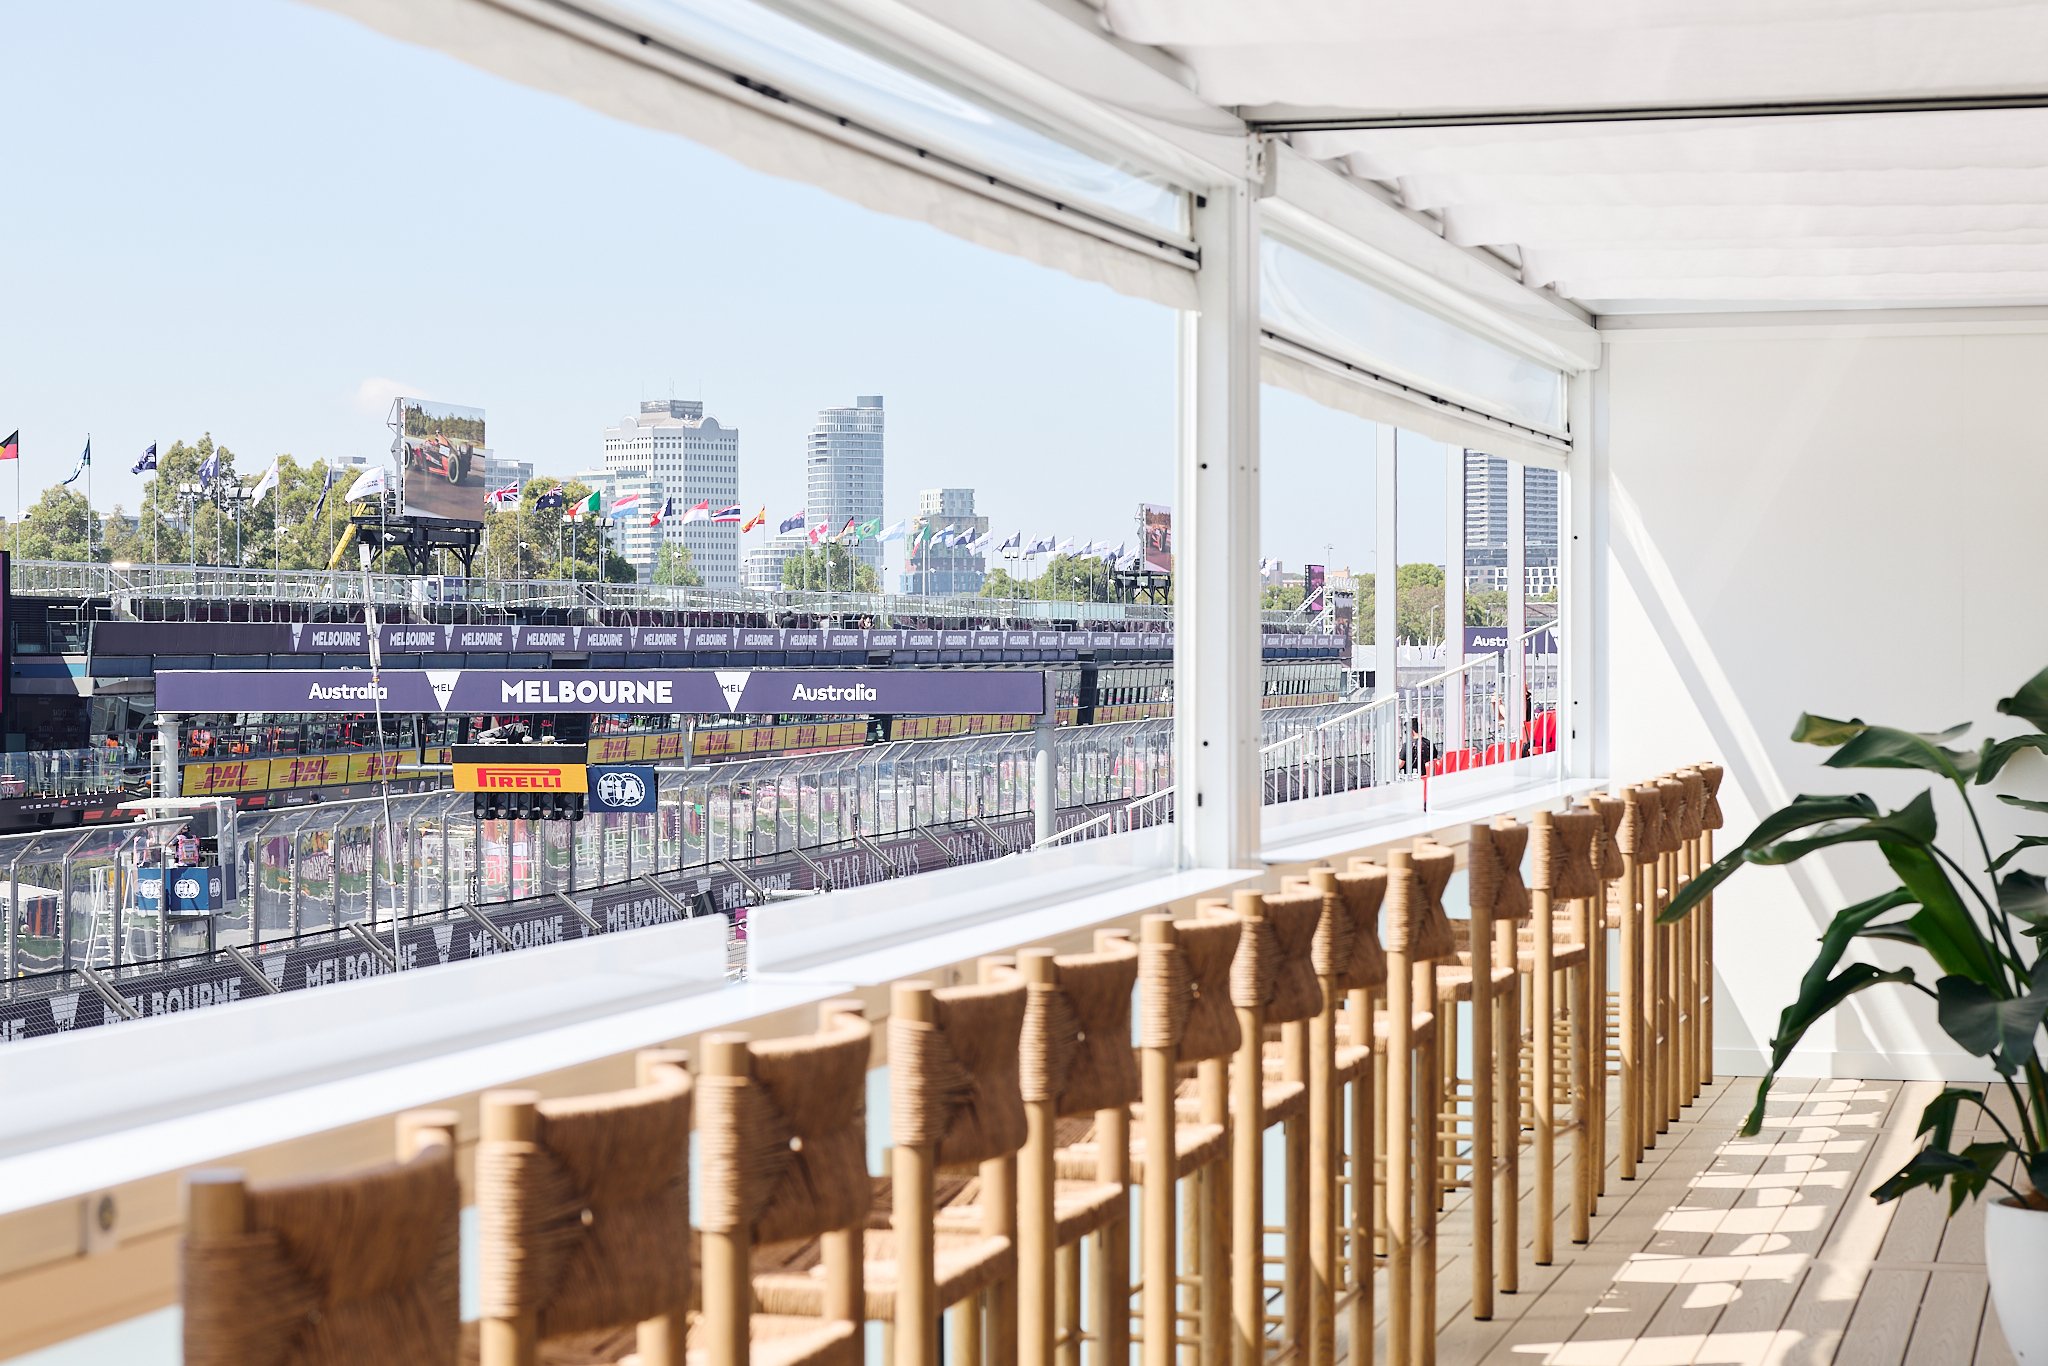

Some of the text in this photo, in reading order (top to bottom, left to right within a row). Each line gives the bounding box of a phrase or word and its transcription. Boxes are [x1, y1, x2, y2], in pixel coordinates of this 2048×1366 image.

[312, 631, 361, 646] MELBOURNE
[390, 631, 435, 646] MELBOURNE
[461, 632, 503, 646] MELBOURNE
[527, 632, 565, 646] MELBOURNE
[587, 633, 623, 646] MELBOURNE
[643, 633, 677, 646] MELBOURNE
[696, 634, 727, 646] MELBOURNE
[744, 634, 774, 646] MELBOURNE
[308, 682, 388, 700] Australia
[432, 684, 453, 692] MEL
[501, 679, 673, 704] MELBOURNE
[721, 684, 743, 693] MEL
[791, 683, 877, 701] Australia
[203, 765, 249, 789] DHL
[288, 760, 330, 783] DHL
[477, 768, 562, 788] PIRELLI
[947, 832, 986, 866] QATAR
[813, 855, 860, 890] QATAR
[723, 873, 791, 910] MELOURNE
